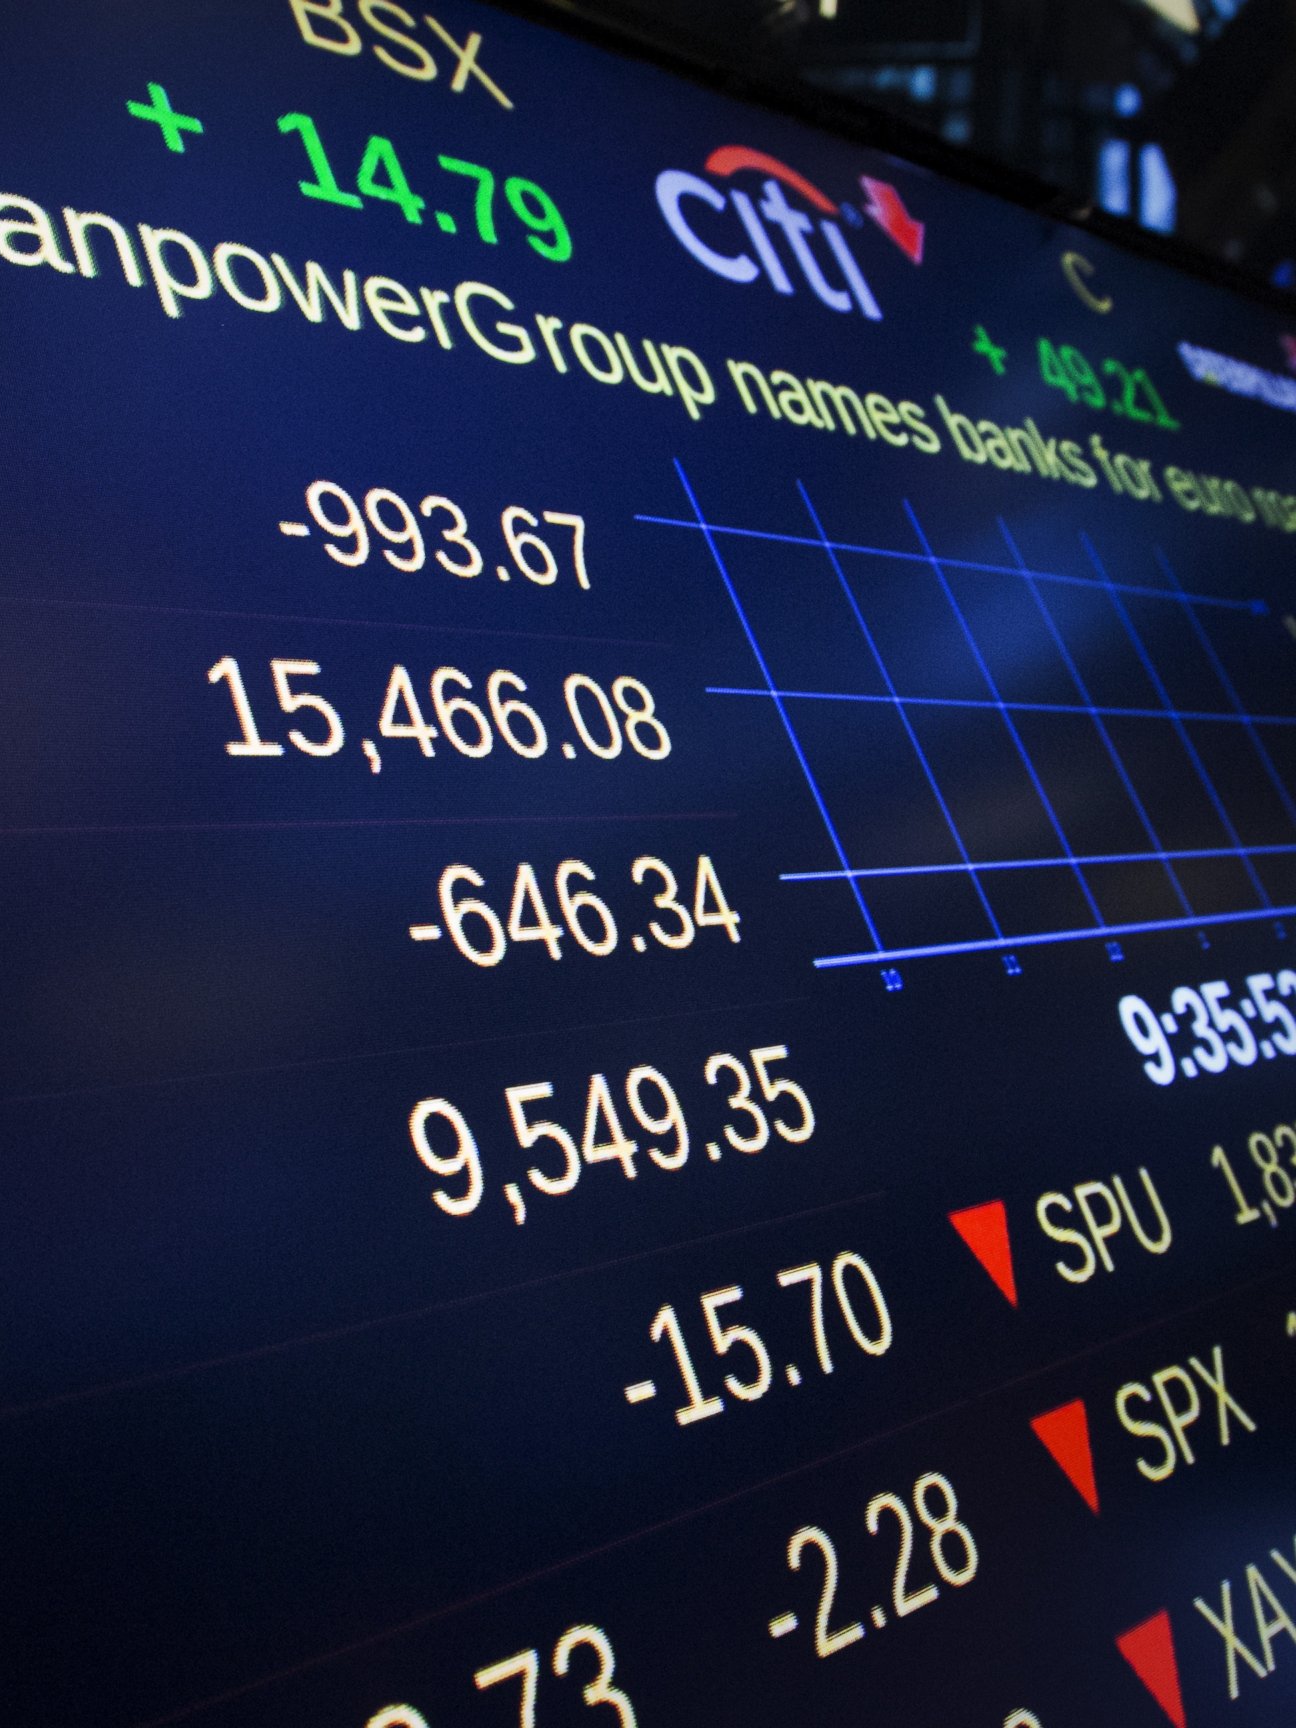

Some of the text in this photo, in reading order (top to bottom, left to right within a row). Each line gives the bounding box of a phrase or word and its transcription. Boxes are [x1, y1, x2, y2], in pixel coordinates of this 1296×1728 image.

[287, 0, 514, 109] BSX
[277, 112, 573, 262] 14.79
[1059, 251, 1113, 313] C
[726, 358, 942, 453] names
[934, 393, 1098, 489] banks
[1037, 337, 1180, 430] 49.21
[278, 480, 591, 590] -993.67
[207, 656, 672, 774] 15,466.08
[408, 854, 742, 967] -646.34
[408, 1044, 816, 1225] 9,549.35
[1035, 1166, 1173, 1284] SPU
[624, 1250, 893, 1426] -15.70
[1114, 1344, 1258, 1483] SPX
[768, 1470, 980, 1658] -2.28
